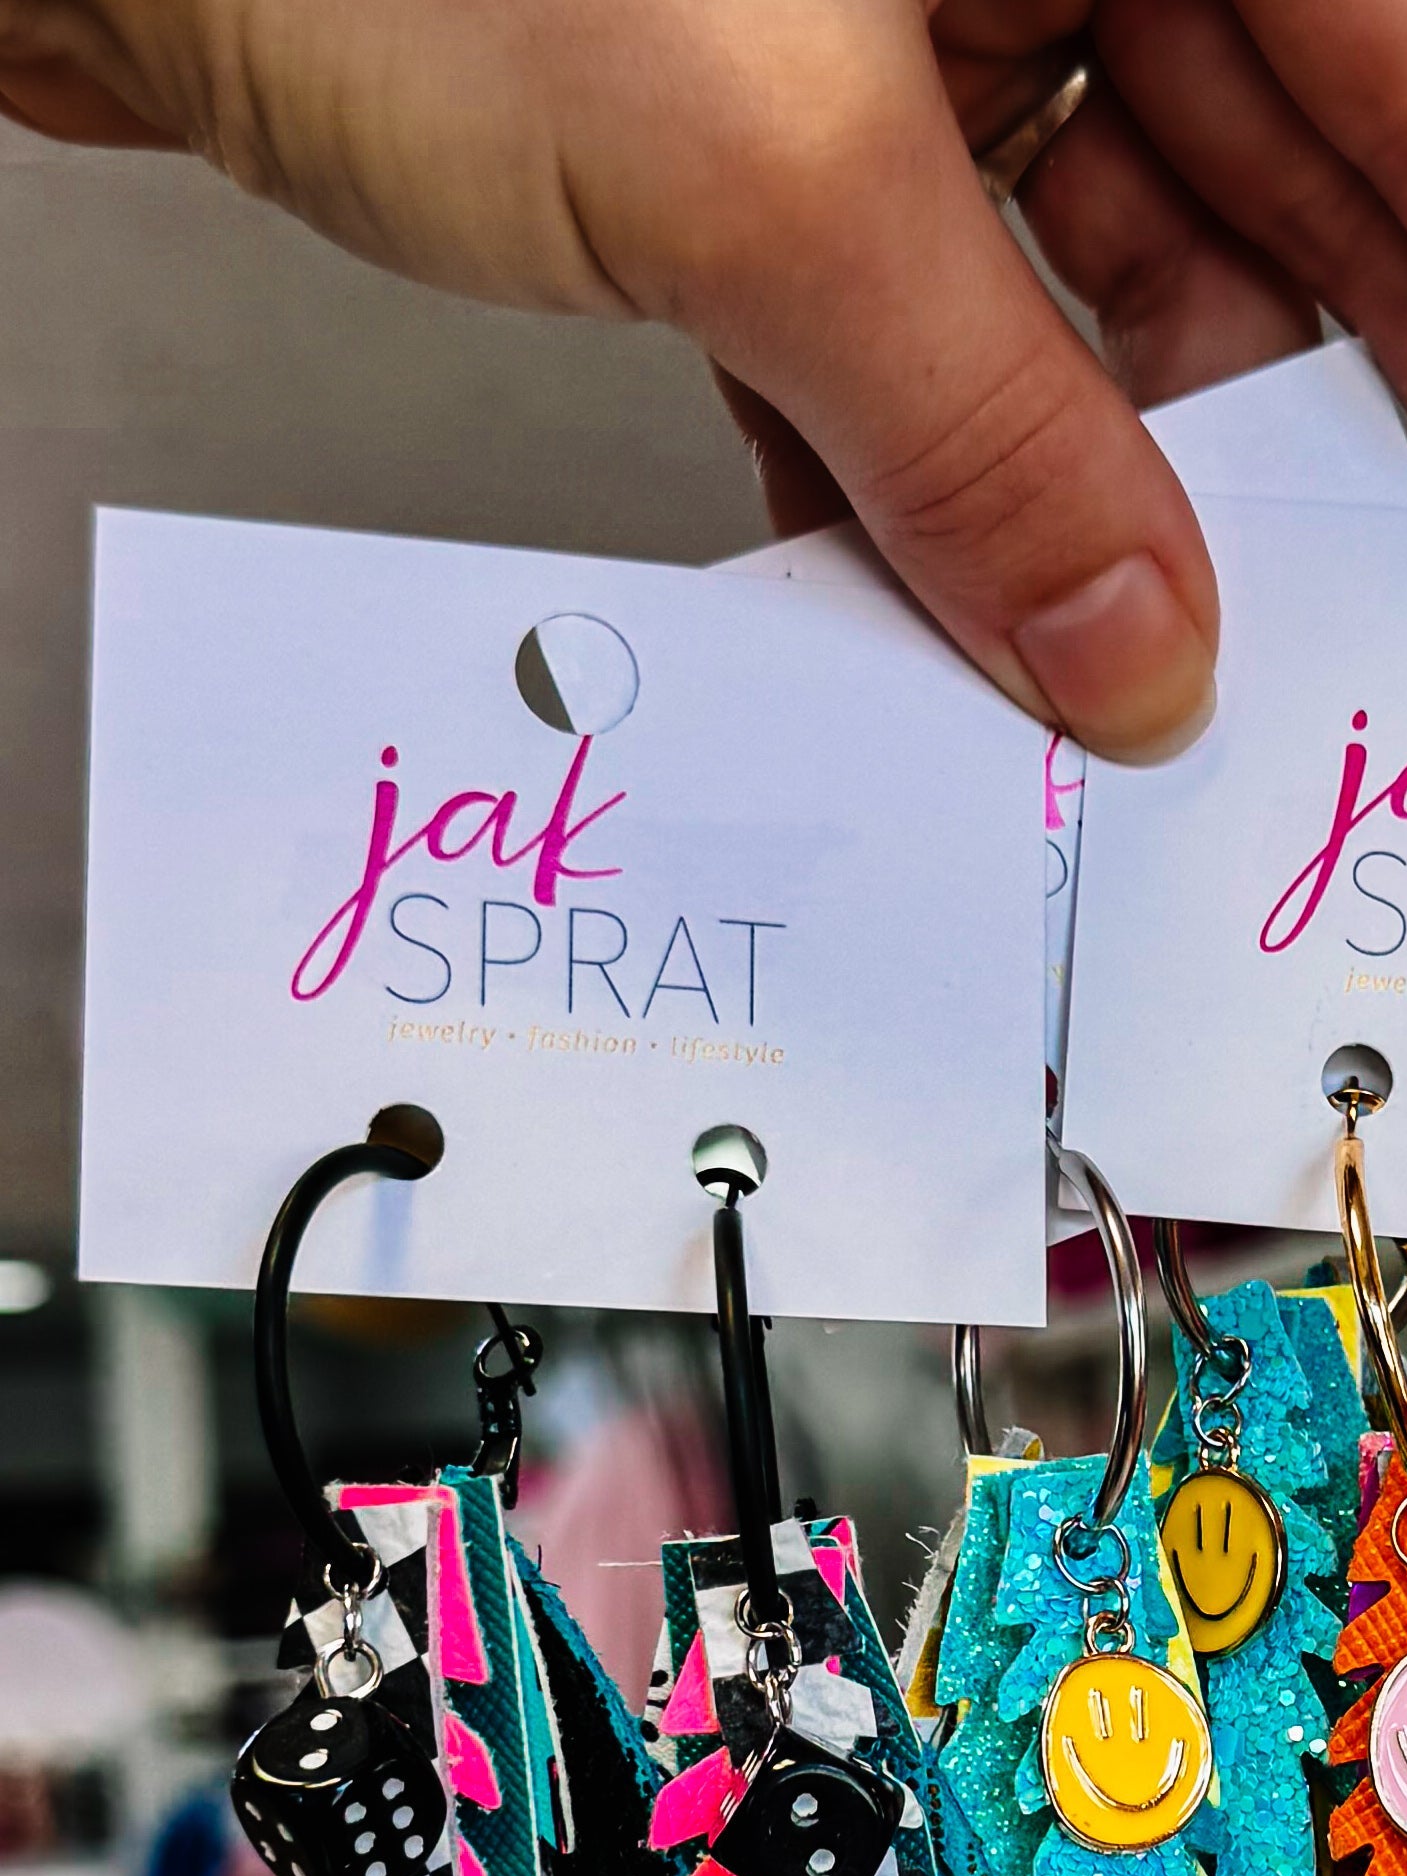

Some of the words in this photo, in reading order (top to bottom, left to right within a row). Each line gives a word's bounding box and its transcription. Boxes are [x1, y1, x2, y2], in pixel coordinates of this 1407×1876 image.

[290, 735, 627, 1002] jak
[384, 892, 788, 1028] SPRAT
[387, 1015, 497, 1050] jewelry
[526, 1024, 637, 1056] fashion
[671, 1034, 786, 1066] lifestyle
